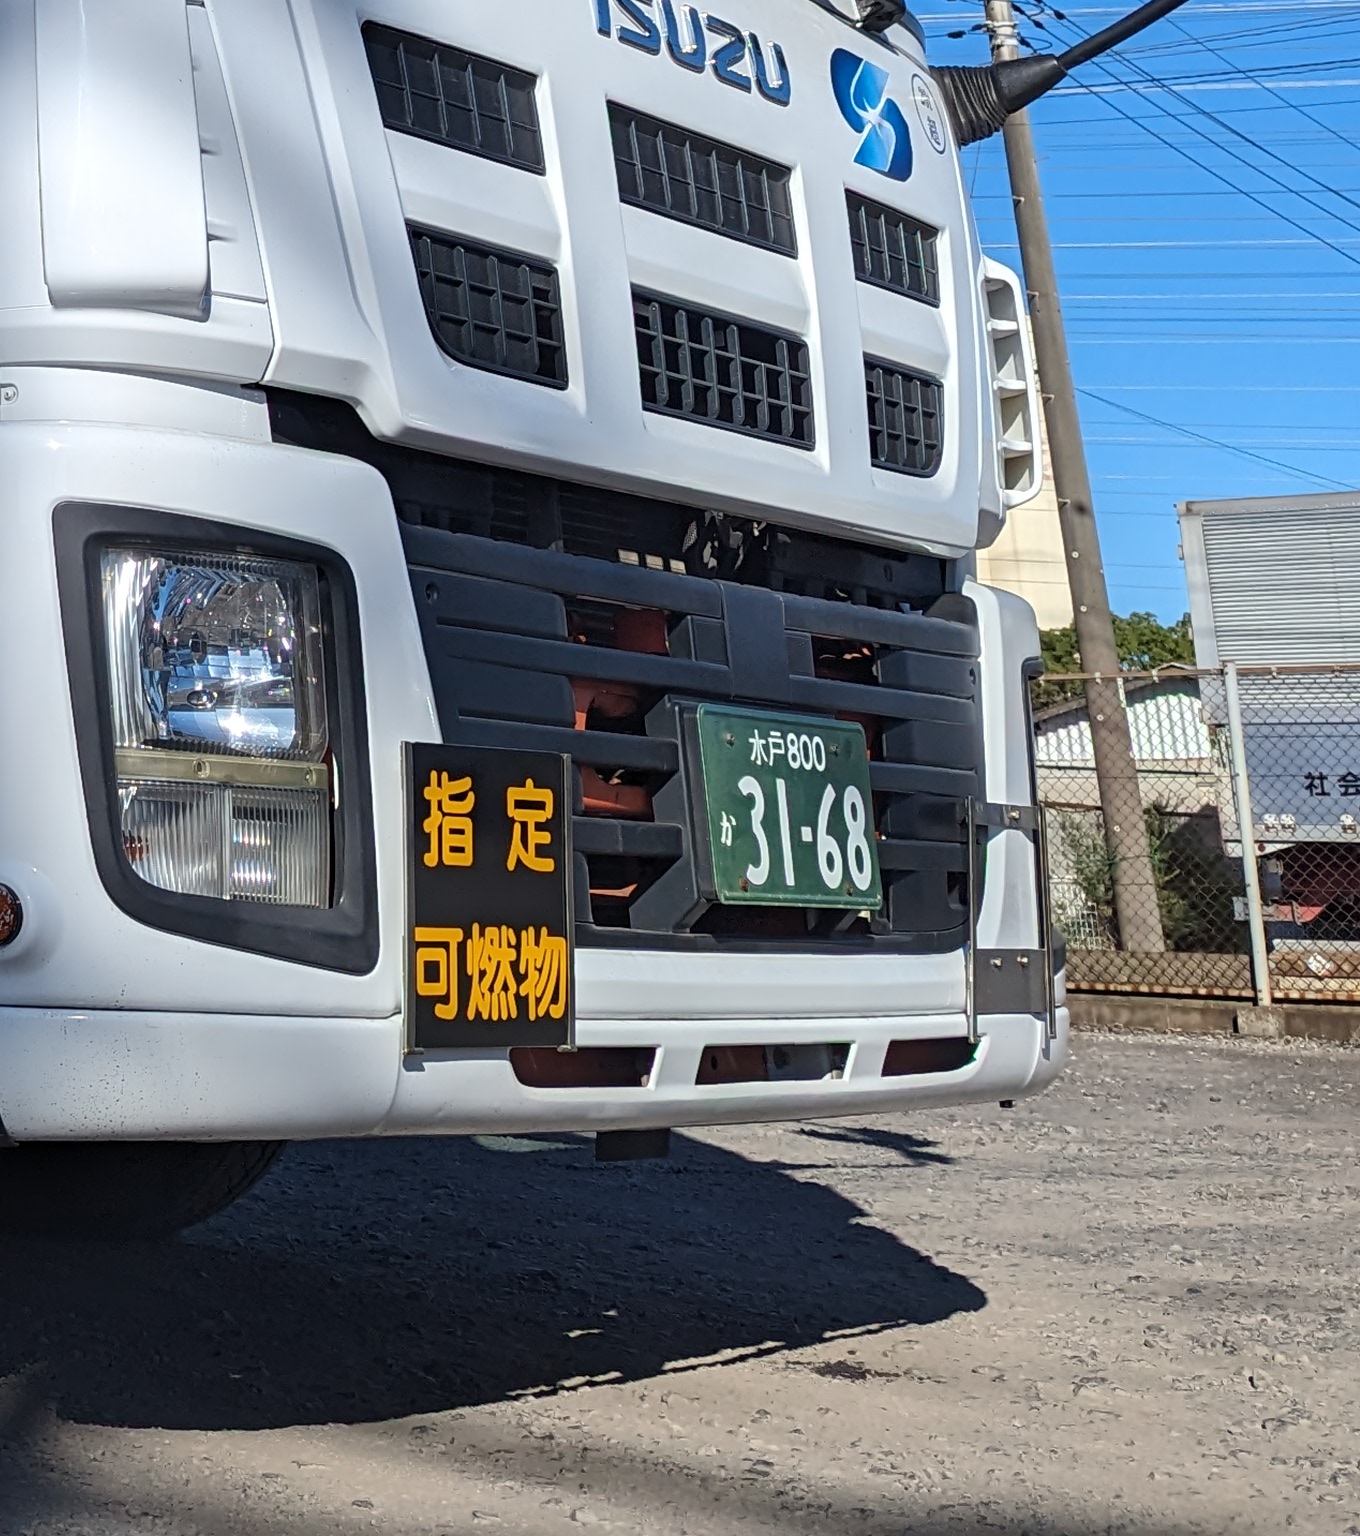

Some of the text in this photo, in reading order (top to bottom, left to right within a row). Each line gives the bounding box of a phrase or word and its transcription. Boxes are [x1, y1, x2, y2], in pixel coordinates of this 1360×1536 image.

[422, 769, 555, 873] 指定
[720, 775, 872, 892] か 31-68
[413, 922, 567, 1022] 可燃物
